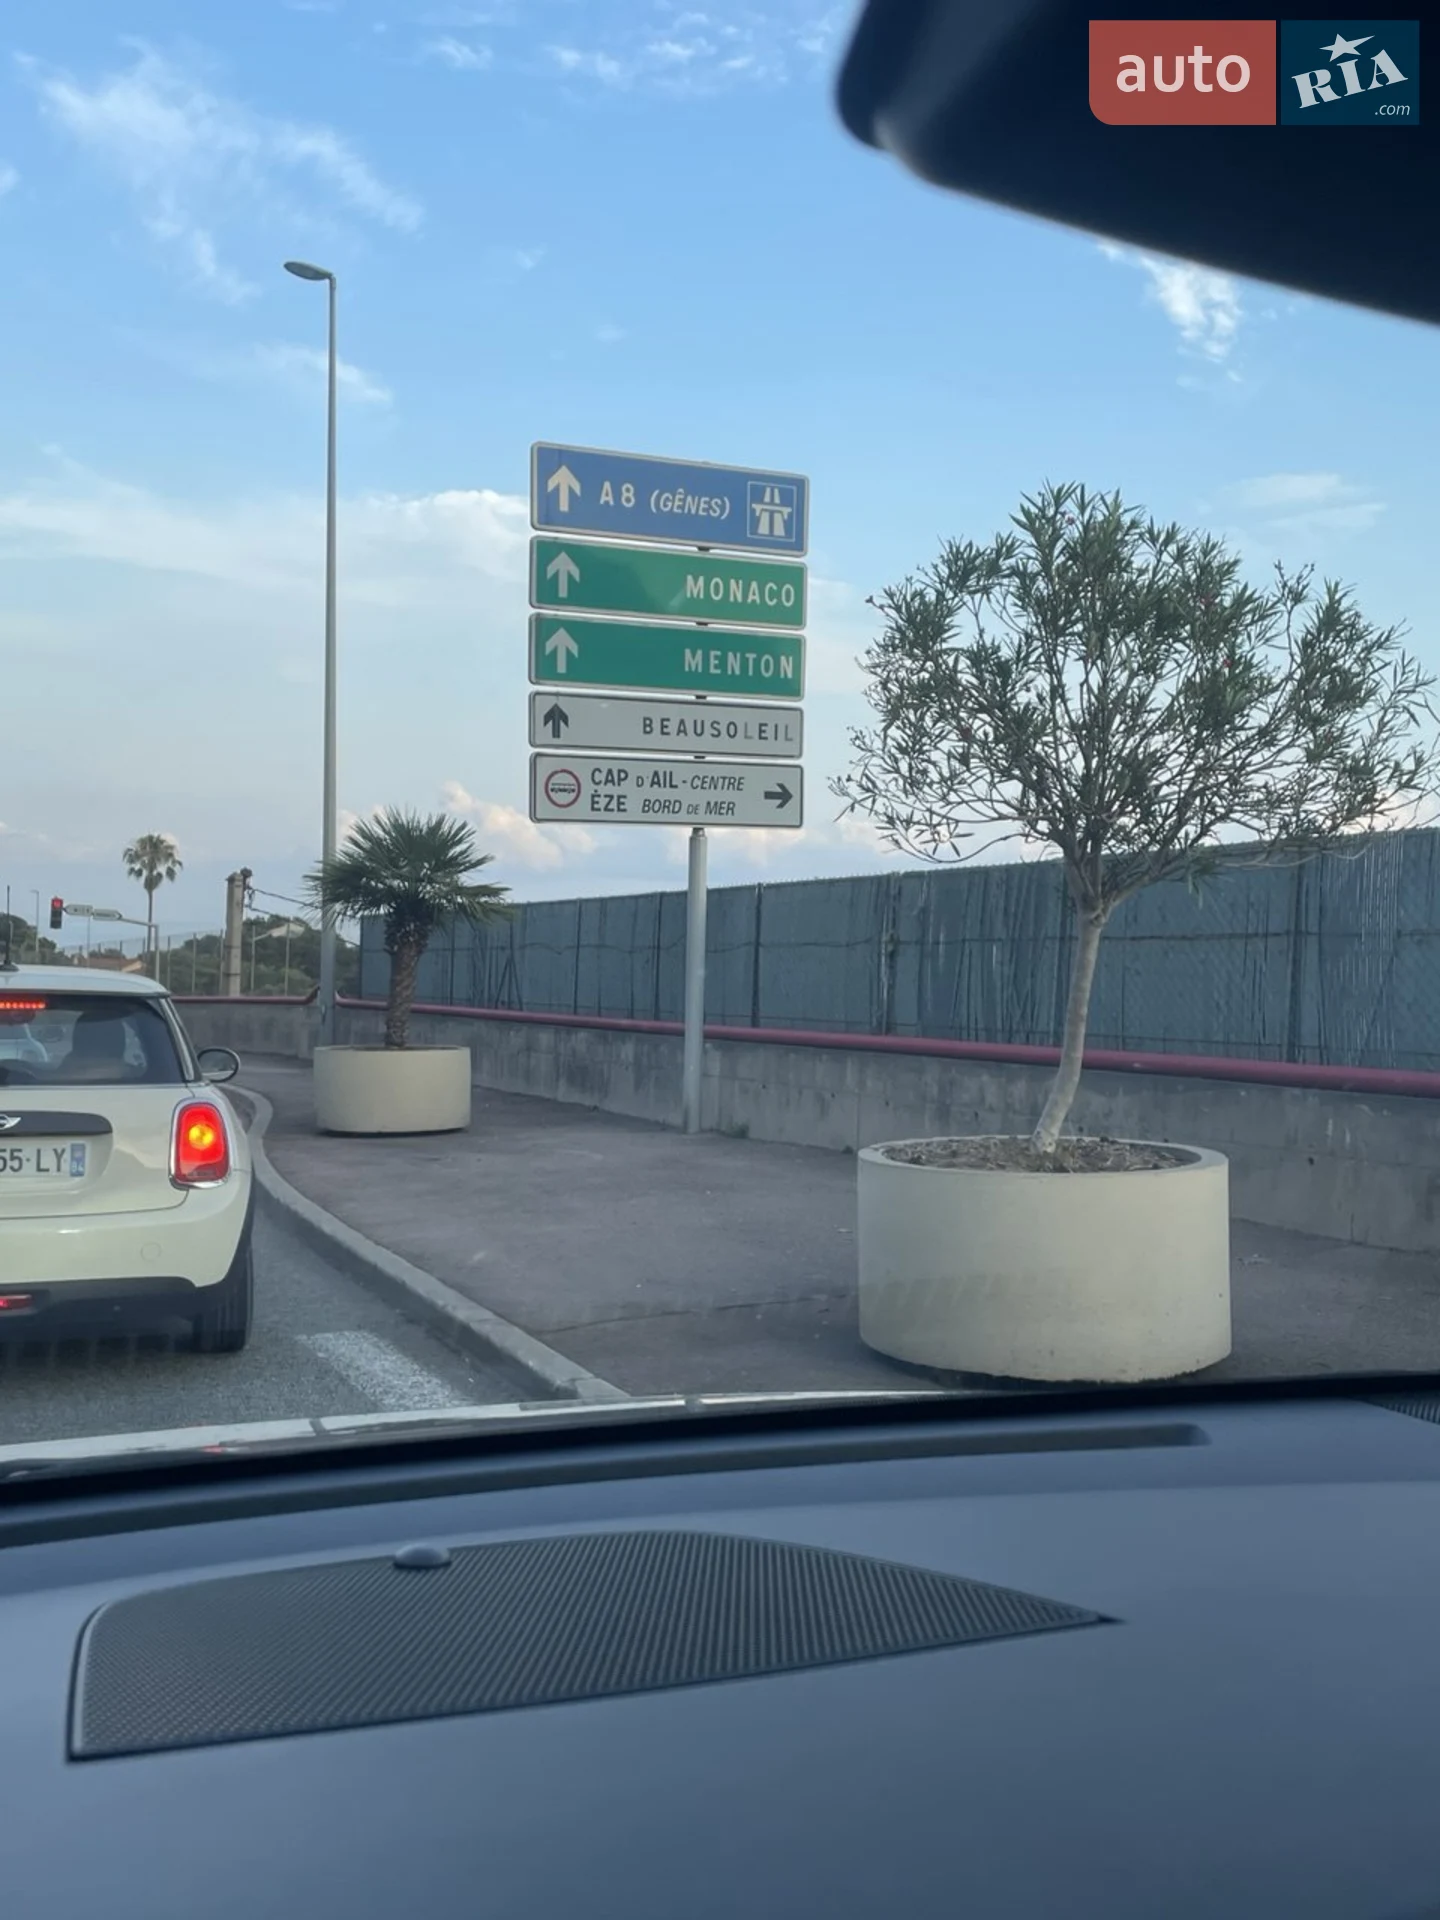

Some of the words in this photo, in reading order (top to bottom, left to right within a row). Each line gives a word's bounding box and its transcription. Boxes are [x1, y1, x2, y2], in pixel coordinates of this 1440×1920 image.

[650, 489, 731, 520] (GÊNES)
[686, 574, 795, 607] MONACO
[684, 649, 794, 679] MENTON
[643, 716, 794, 742] BEAUSOLEIL
[590, 767, 629, 787] CAP
[641, 799, 682, 815] BORD
[686, 804, 700, 815] DE
[704, 801, 736, 816] MER
